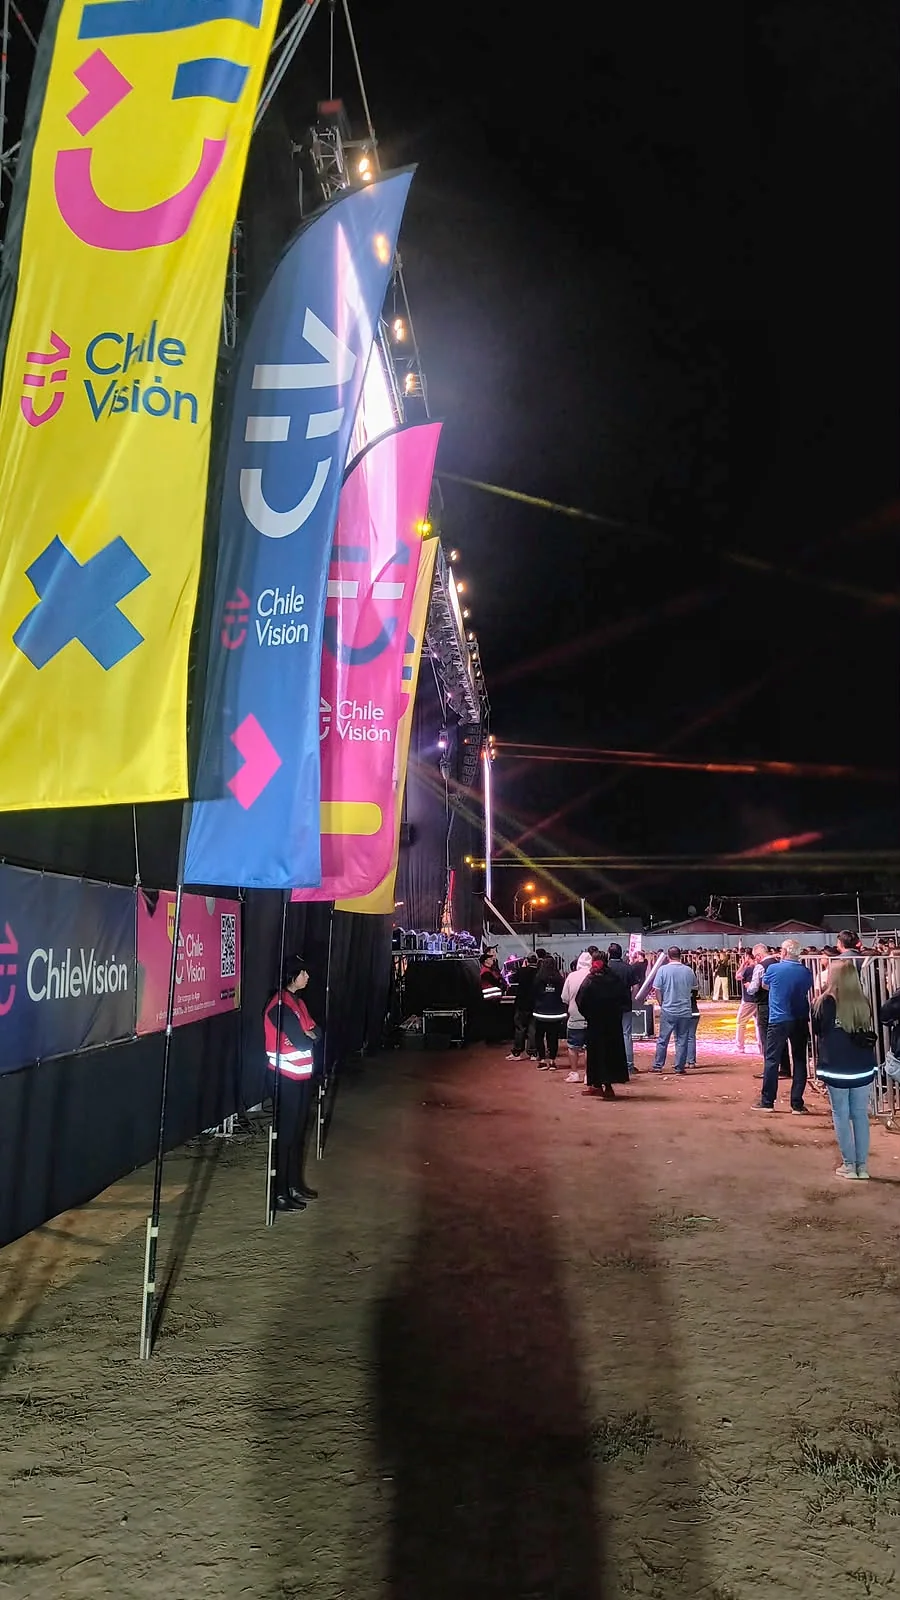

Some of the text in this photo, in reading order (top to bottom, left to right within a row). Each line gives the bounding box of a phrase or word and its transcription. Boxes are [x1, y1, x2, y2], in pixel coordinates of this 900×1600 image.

[85, 319, 187, 375] Chile
[256, 585, 305, 617] Chile
[255, 618, 309, 646] Visión
[338, 700, 385, 721] Chile
[336, 720, 391, 742] Visión
[185, 932, 204, 957] Chile
[26, 947, 128, 1002] ChileVisión
